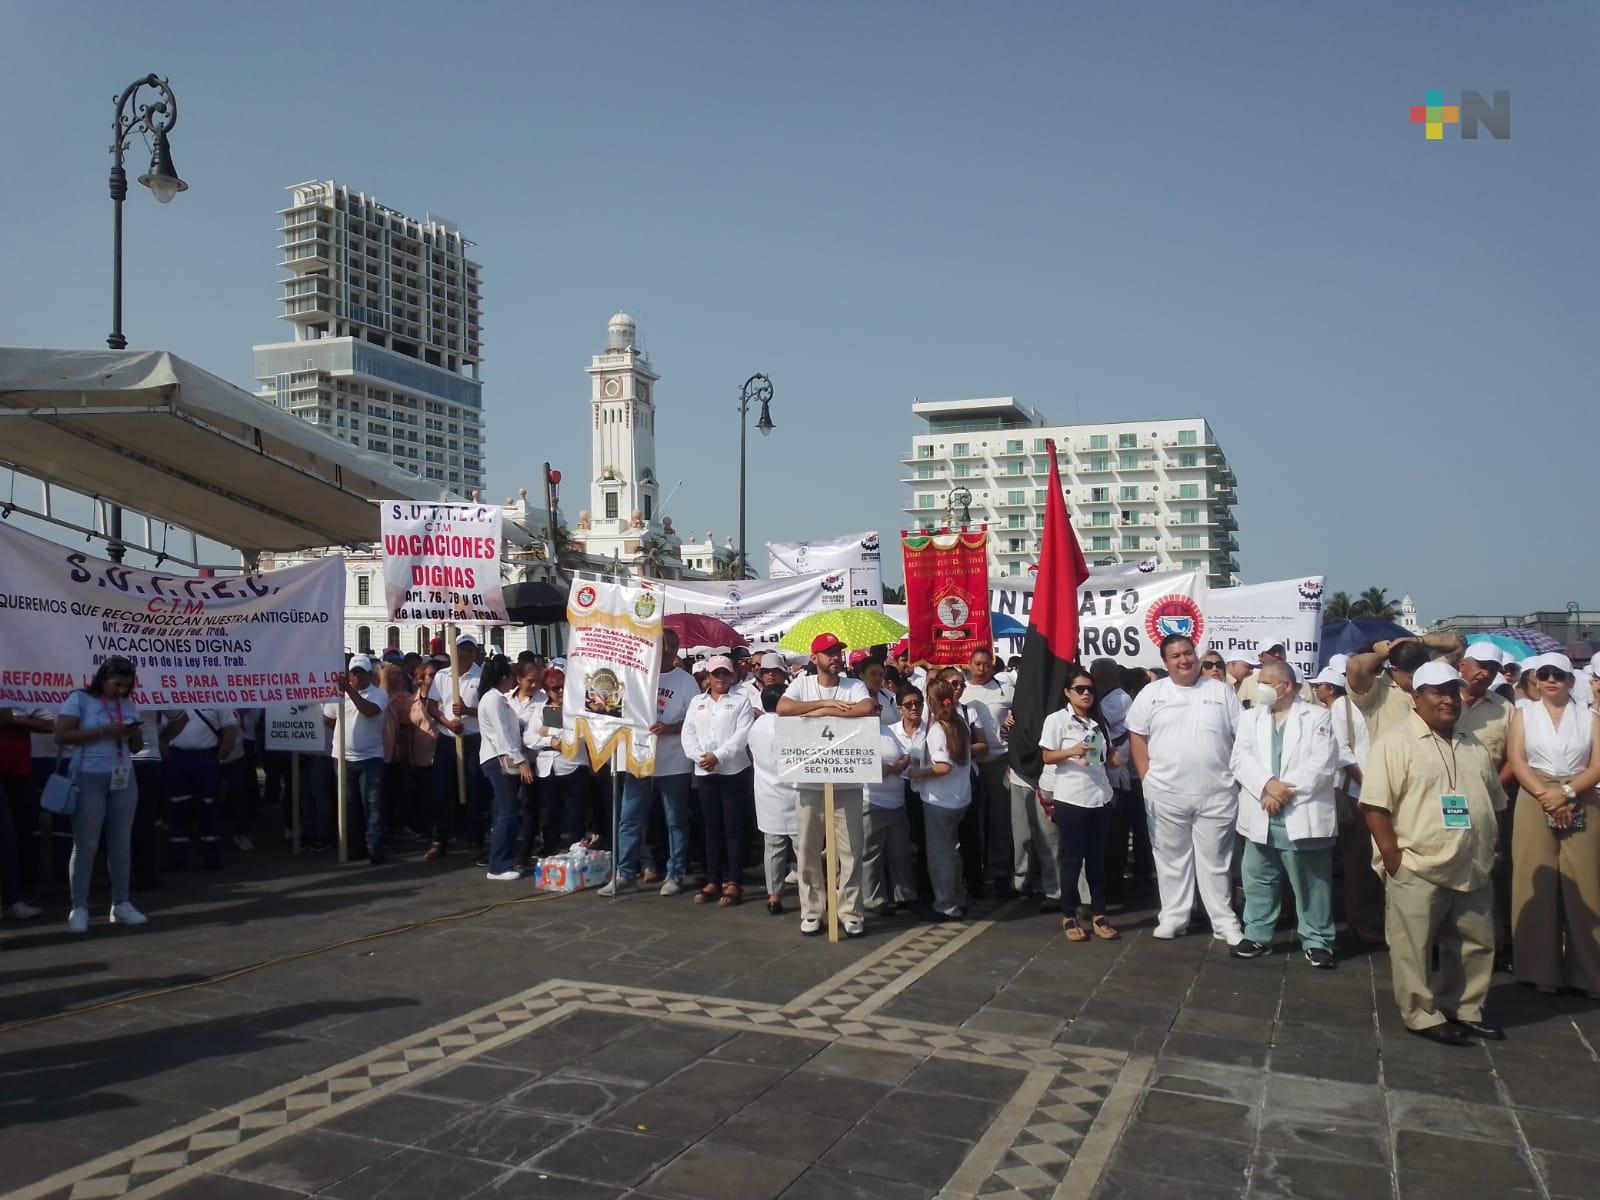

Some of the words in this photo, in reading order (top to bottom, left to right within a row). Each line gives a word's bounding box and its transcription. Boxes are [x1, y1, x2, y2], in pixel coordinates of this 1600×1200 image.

[385, 534, 496, 560] VACACIONES
[411, 565, 475, 589] DIGNAS
[147, 596, 205, 615] C.T.M.
[405, 590, 426, 603] Art.
[449, 592, 459, 603] 78
[462, 593, 469, 606] y
[472, 594, 483, 605] 81
[0, 593, 67, 614] QUEREMOS
[71, 602, 100, 617] QUE
[102, 607, 203, 627] RECONOZCAN
[203, 613, 249, 626] NUESTRA
[251, 608, 328, 623] ANTIGÜEDAD
[395, 608, 408, 619] de
[412, 608, 422, 620] la
[426, 608, 445, 620] Ley
[448, 608, 472, 620] Fed.
[472, 610, 503, 620] Trab.
[102, 620, 120, 633] Art.
[122, 623, 141, 634] 273
[141, 625, 155, 635] de
[156, 627, 167, 637] la
[168, 627, 184, 637] Ley
[185, 626, 203, 636] Fed.
[205, 626, 229, 636] Trab.
[85, 634, 94, 649] Y
[98, 635, 191, 653] VACACIONES
[196, 639, 252, 653] DIGNAS
[141, 656, 146, 668] y
[148, 655, 159, 667] 81
[160, 656, 172, 667] de
[174, 655, 183, 667] la
[185, 656, 201, 668] Ley
[203, 656, 222, 667] Fed.
[224, 655, 247, 667] Trab.
[2, 670, 74, 687] REFORMA
[162, 675, 176, 688] ES
[186, 675, 218, 688] PARA
[228, 673, 300, 687] BENEFICIAR
[308, 672, 316, 684] A
[152, 692, 169, 705] EL
[171, 689, 237, 704] BENEFICIO
[240, 689, 257, 702] DE
[260, 688, 283, 701] LAS
[271, 720, 315, 729] SINDICATO
[821, 725, 835, 741] 4
[781, 748, 829, 756] SINDICATO
[844, 757, 873, 765] SNTSS
[804, 766, 822, 774] SEC
[832, 766, 855, 774] IMSS
